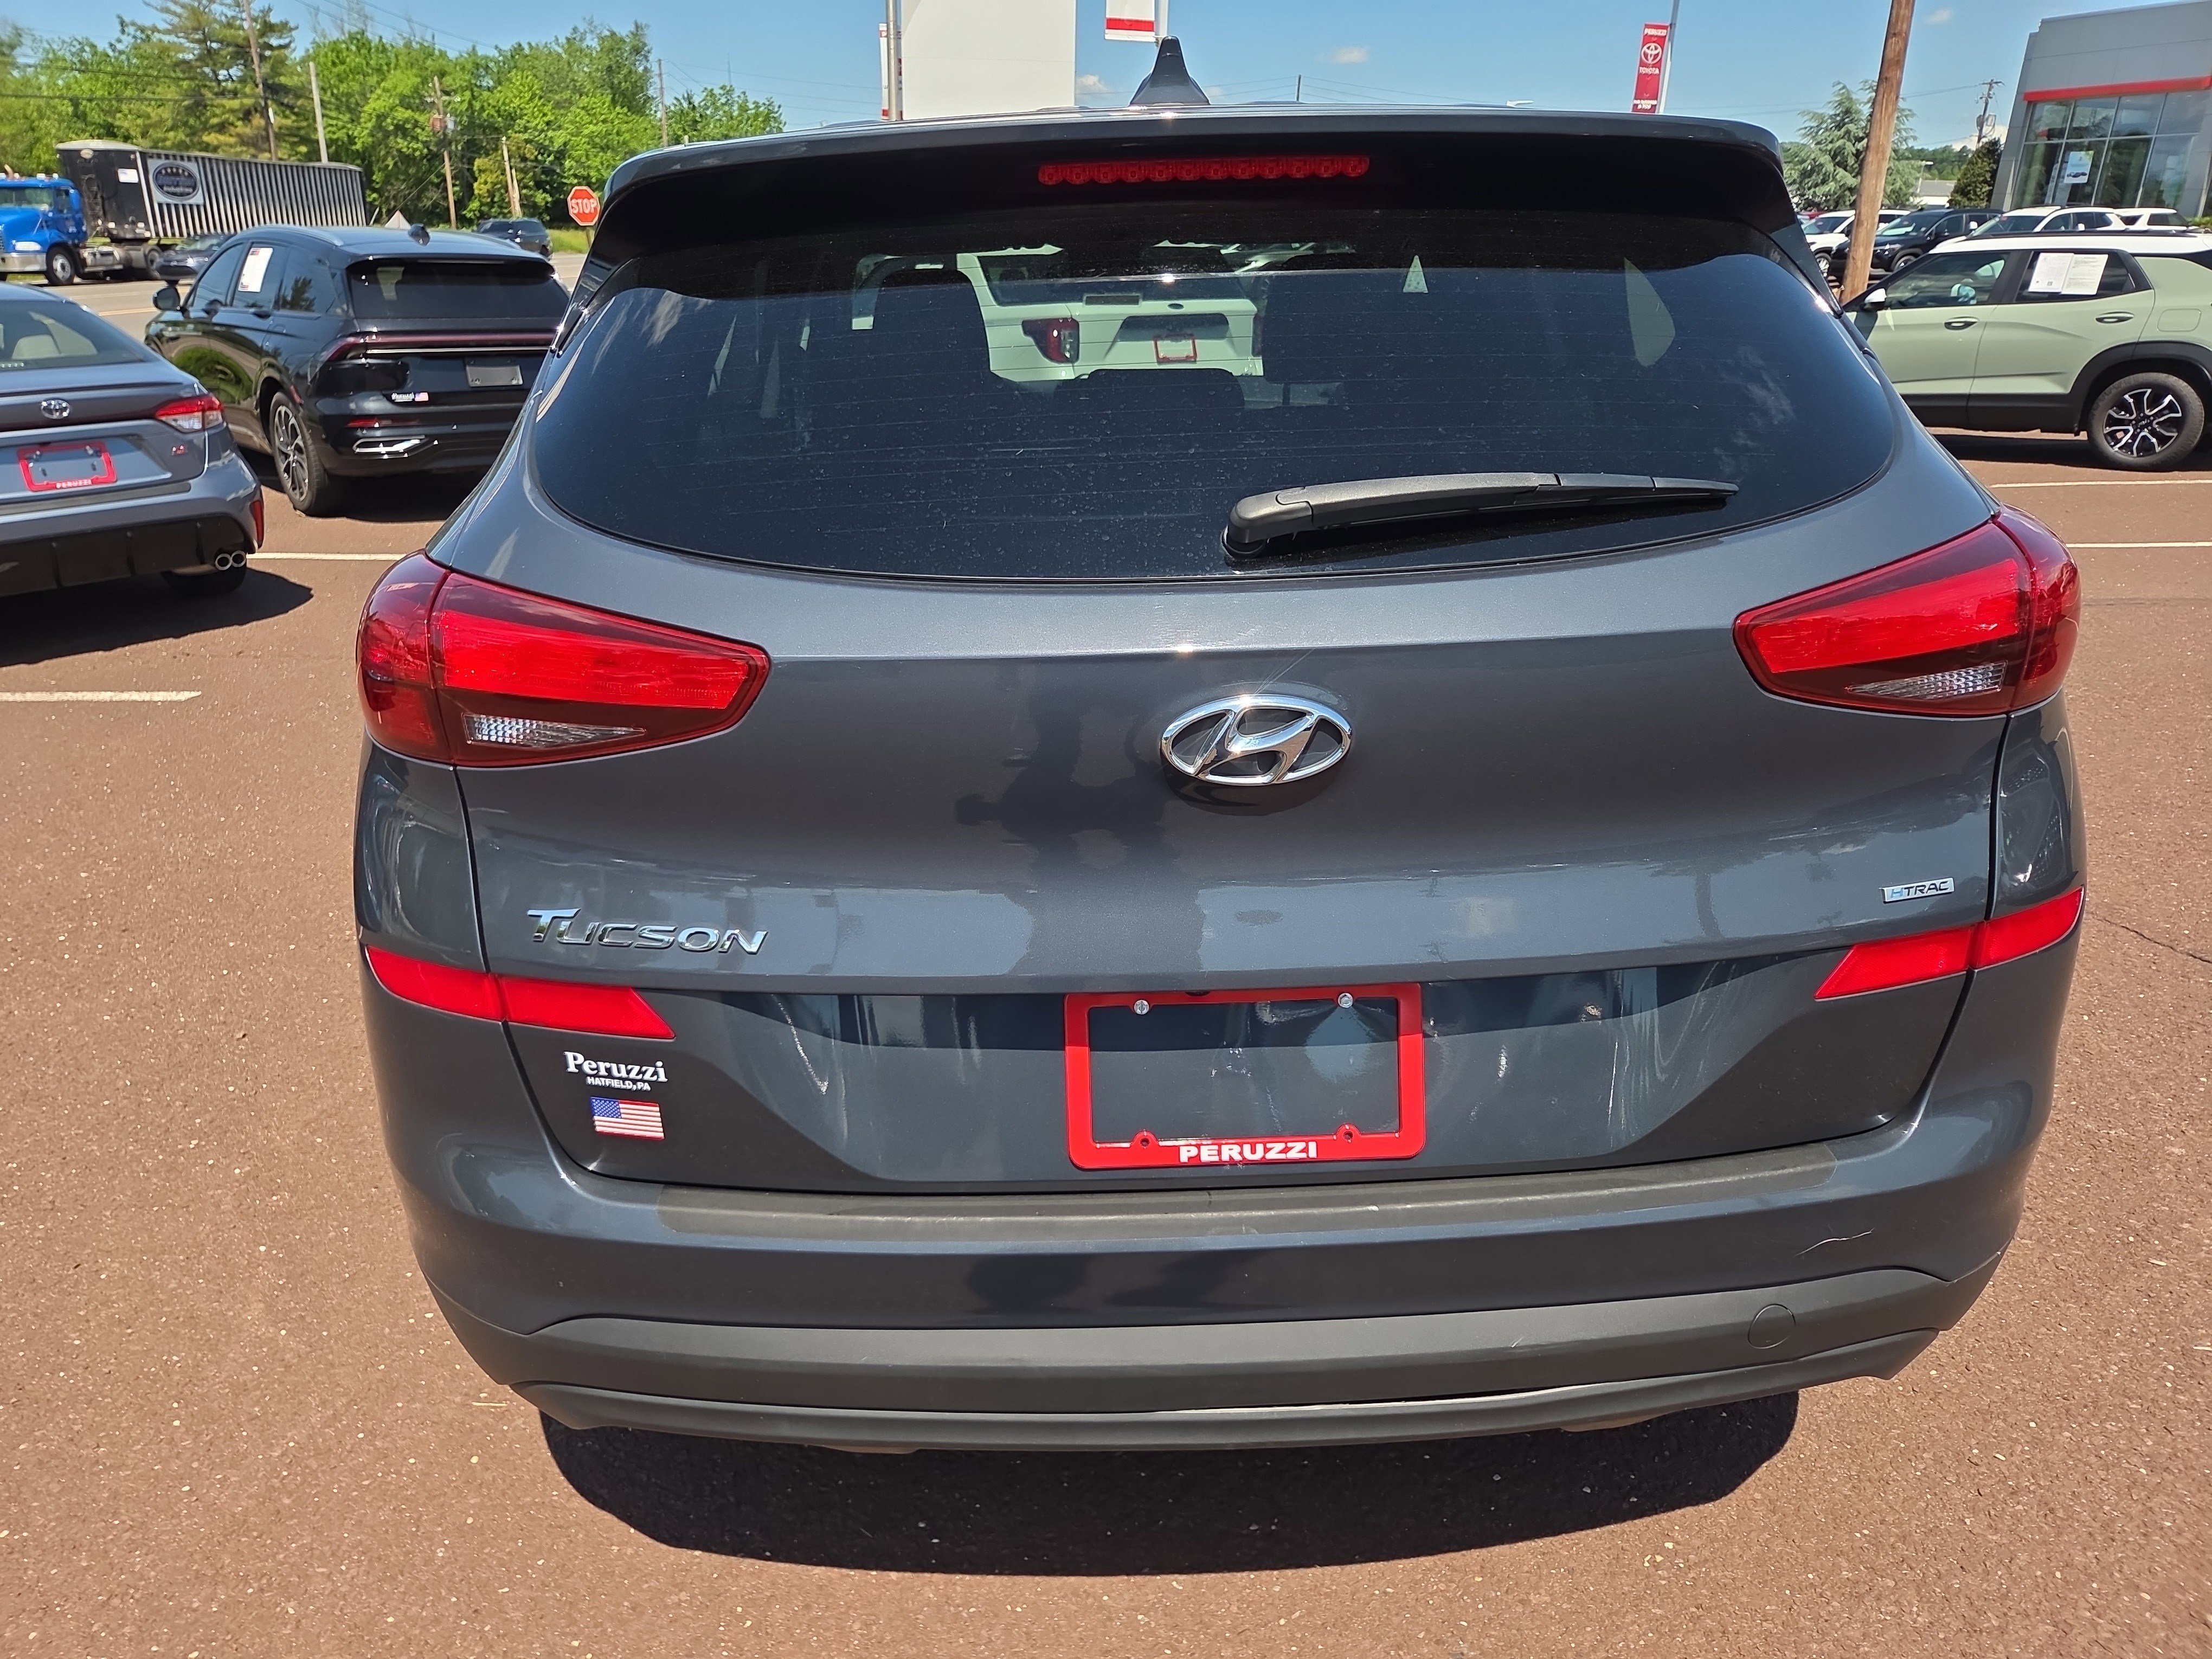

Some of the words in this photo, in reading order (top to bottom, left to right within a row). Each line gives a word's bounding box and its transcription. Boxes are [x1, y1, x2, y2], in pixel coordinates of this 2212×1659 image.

[571, 198, 597, 214] STOP
[1890, 880, 1950, 898] HTRAC
[527, 908, 768, 955] TUCSON
[563, 1051, 668, 1082] Peruzzi
[1179, 1141, 1317, 1163] PERUZZI
